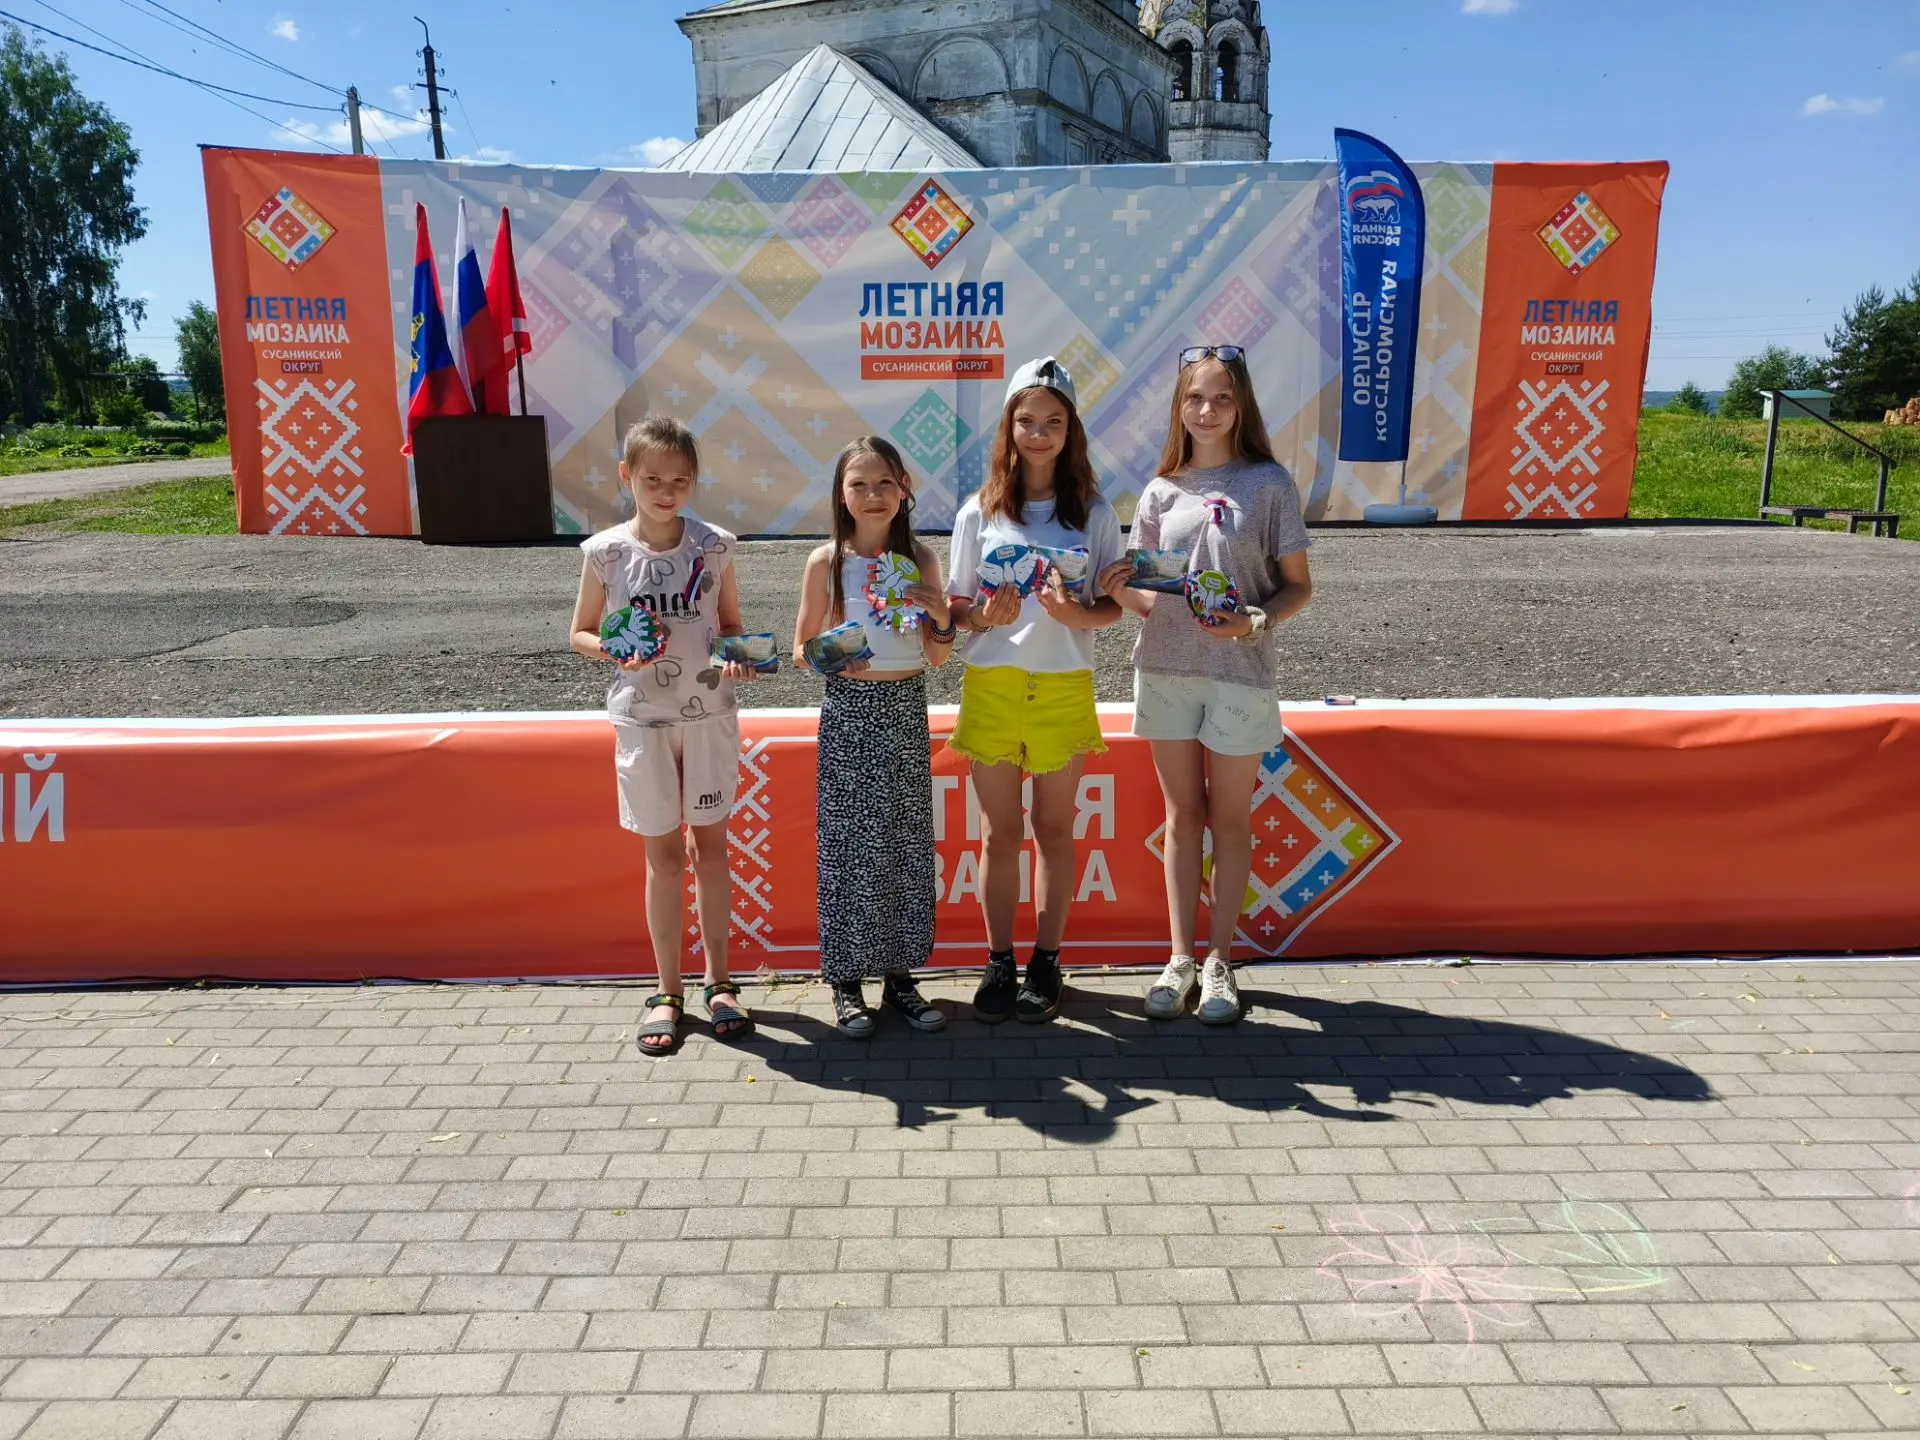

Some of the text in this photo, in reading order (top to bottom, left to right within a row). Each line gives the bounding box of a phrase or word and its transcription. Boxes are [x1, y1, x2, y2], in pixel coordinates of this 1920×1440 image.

[245, 296, 346, 320] ЛЕТНЯЯ
[859, 282, 1004, 317] ЛЕТНЯЯ
[1523, 299, 1618, 323] ЛЕТНЯЯ
[245, 322, 350, 343] МОЗАИКА
[860, 320, 1005, 350] МОЗАИКА
[1520, 325, 1615, 345] МОЗАИКА
[262, 349, 342, 359] СУСАНИНСКИЙ
[1531, 351, 1603, 361] СУСАНИНСКИЙ
[283, 362, 320, 372] ОКРУГ
[872, 360, 989, 372] СУСАНИНСКИЙ ОКРУГ
[1548, 364, 1580, 373] ОКРУГ
